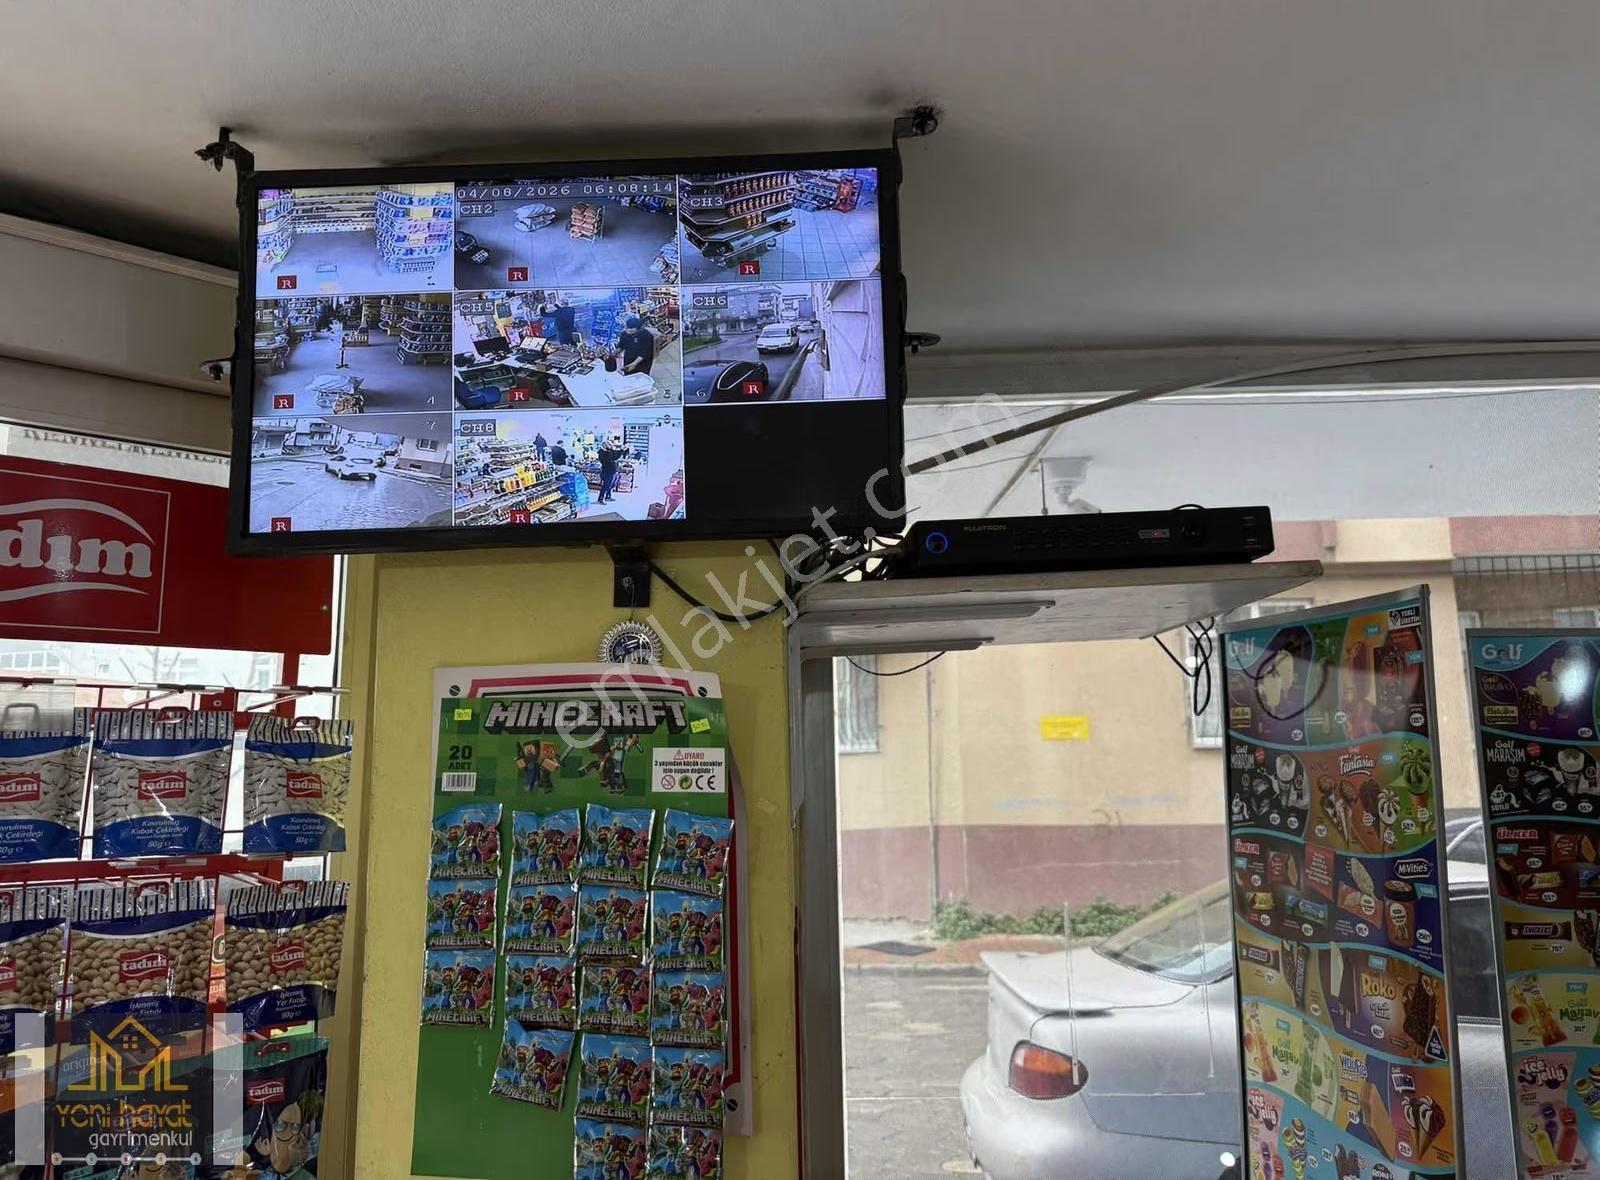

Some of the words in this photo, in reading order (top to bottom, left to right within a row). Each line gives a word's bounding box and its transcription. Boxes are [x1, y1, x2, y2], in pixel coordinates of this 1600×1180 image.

[457, 186, 571, 199] 04/08/2026
[583, 182, 673, 195] 06:08:14
[690, 196, 723, 207] CH3
[461, 203, 493, 214] CH2
[693, 295, 727, 307] CH6
[461, 421, 495, 434] CH8
[0, 519, 152, 578] dım
[484, 701, 688, 734] MINECRAFT
[449, 745, 472, 760] 20
[448, 762, 472, 770] ADET
[1338, 754, 1376, 775] Fantasia
[0, 780, 38, 793] adım
[140, 778, 184, 791] tadım
[288, 779, 321, 791] tadım
[122, 954, 167, 971] tadım
[271, 951, 304, 963] tadım
[515, 1011, 570, 1023] INECRAFT
[1523, 1058, 1546, 1075] ice
[249, 1084, 284, 1097] tadım
